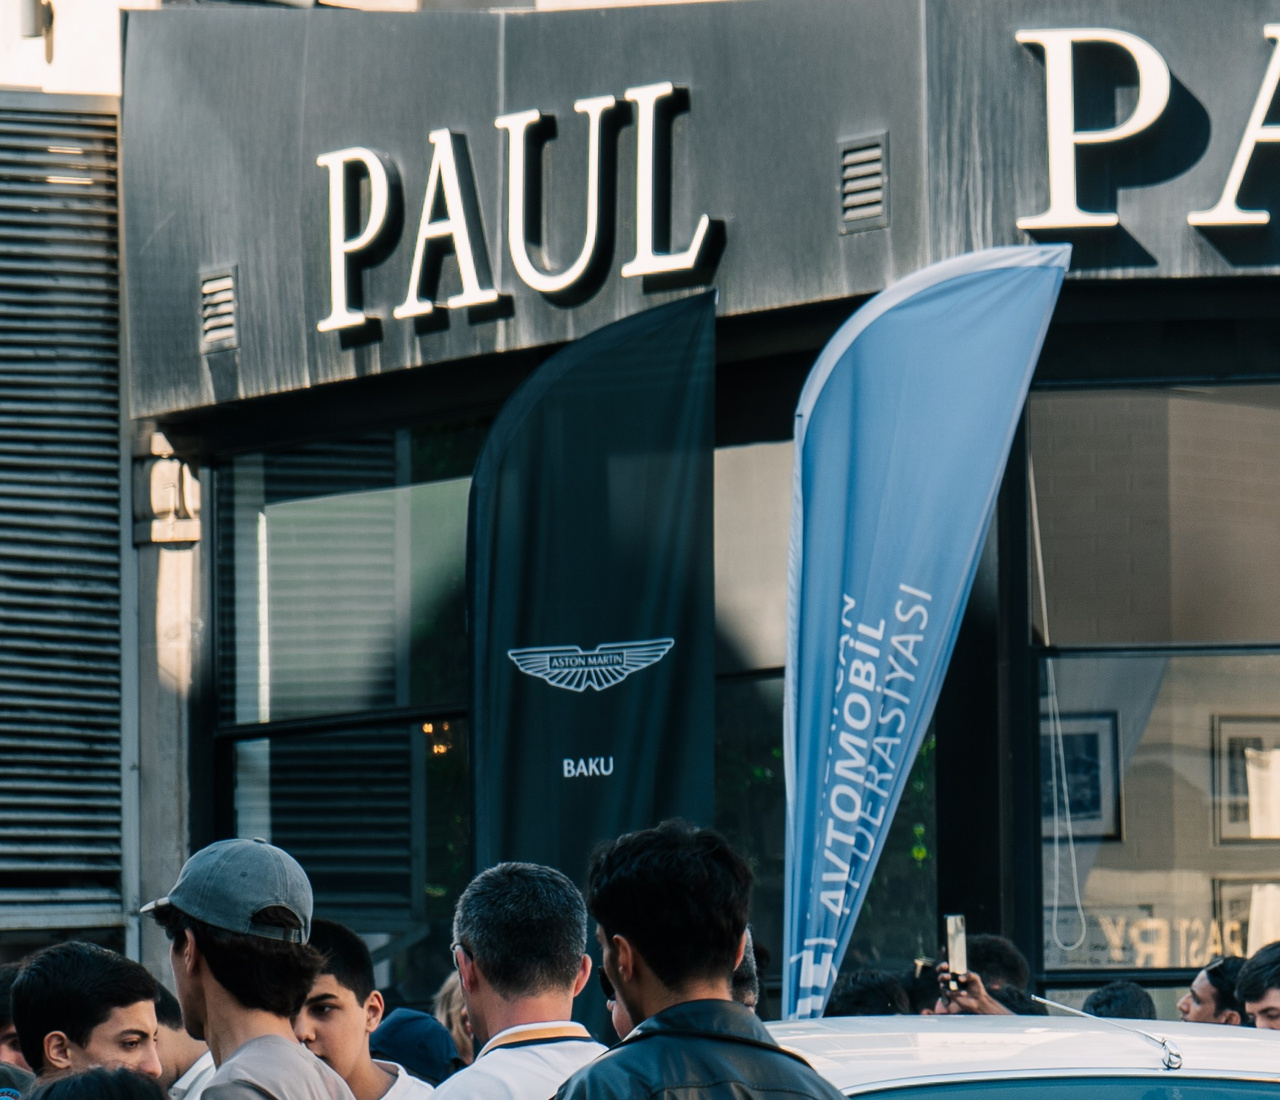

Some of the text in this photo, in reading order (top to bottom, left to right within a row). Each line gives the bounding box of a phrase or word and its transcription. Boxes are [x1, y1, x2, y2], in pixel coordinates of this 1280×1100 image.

[316, 81, 711, 333] PAUL
[551, 654, 623, 668] ASTON MARTIN
[563, 756, 614, 778] BAKU
